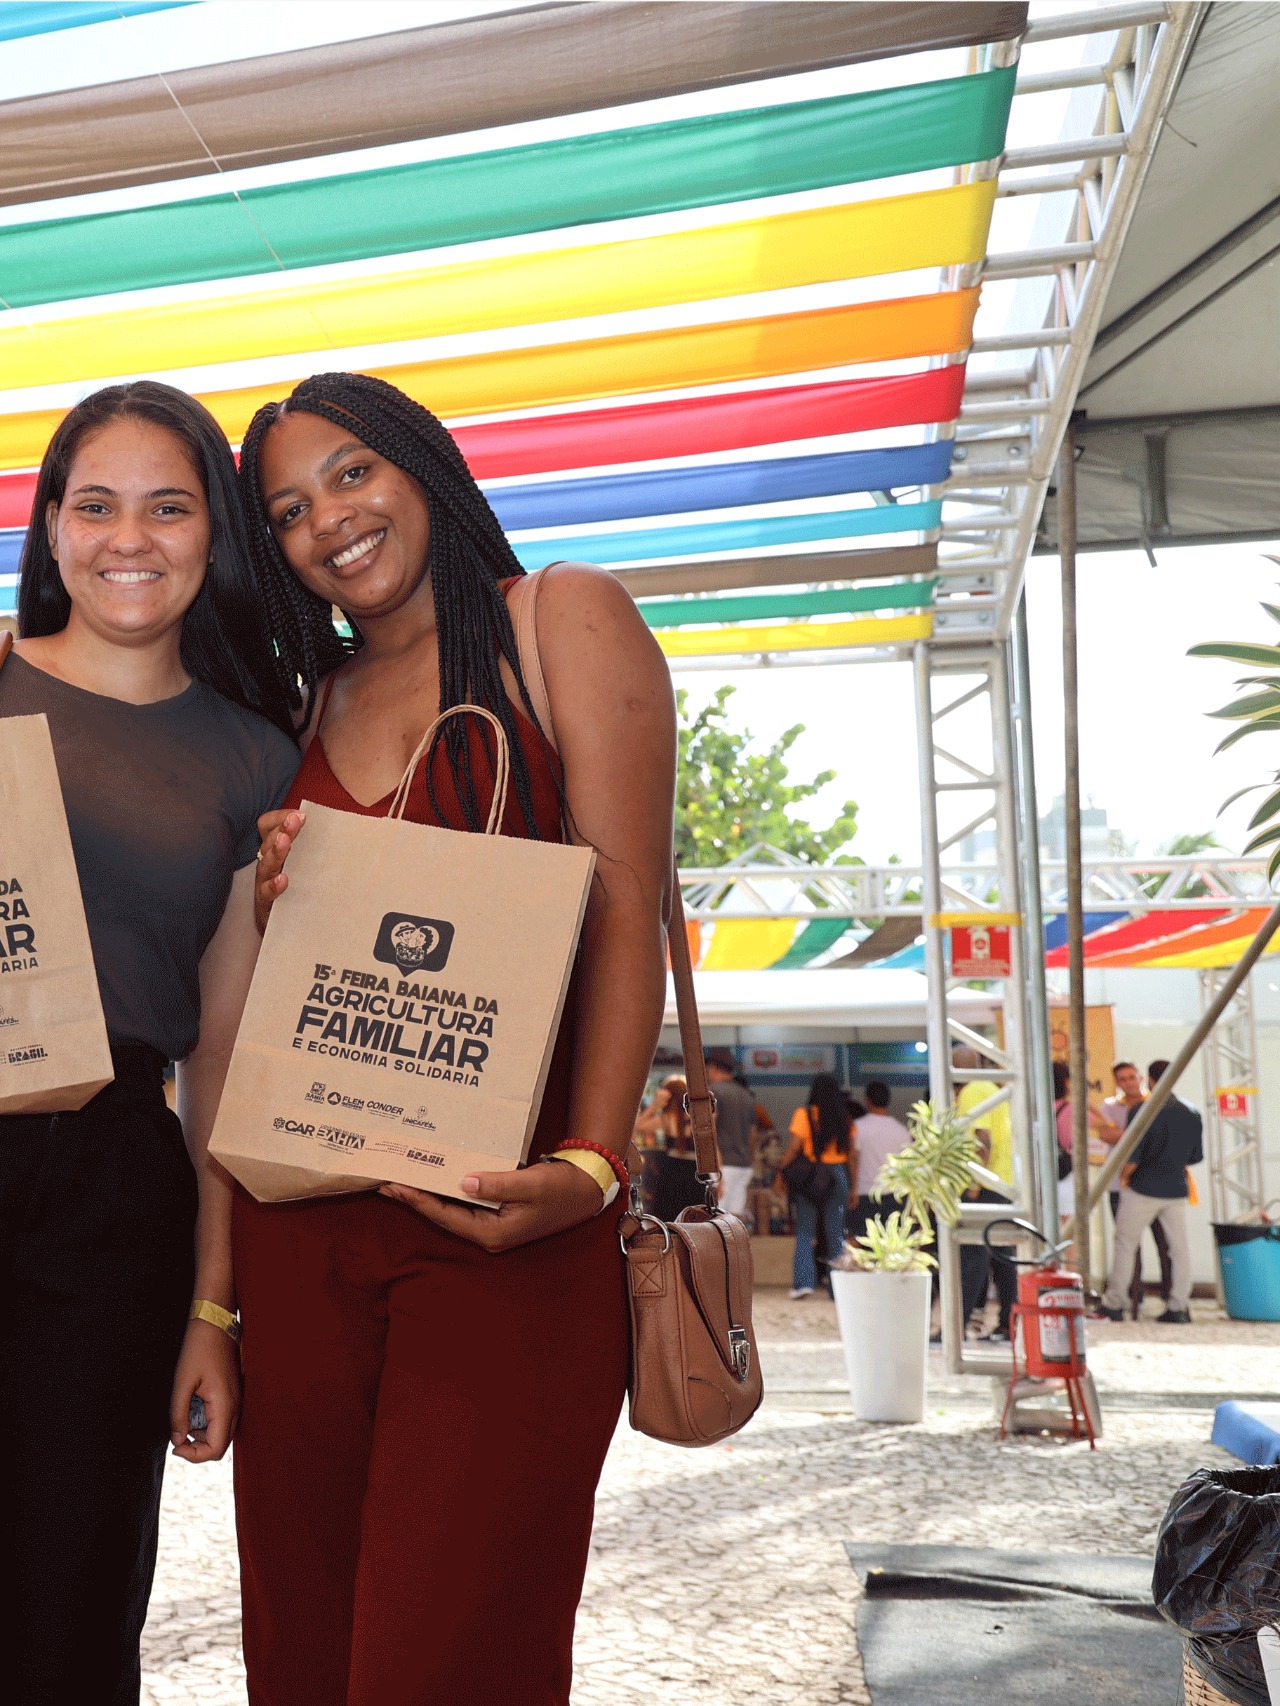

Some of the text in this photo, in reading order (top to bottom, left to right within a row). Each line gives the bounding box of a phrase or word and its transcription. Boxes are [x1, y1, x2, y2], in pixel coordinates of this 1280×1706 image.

[340, 969, 390, 993] FEIRA
[396, 981, 467, 1009] BAIANA
[473, 996, 498, 1015] DA
[306, 983, 494, 1038] AGRICULTURA
[295, 1004, 489, 1073] FAMILIAR
[292, 1037, 479, 1087] E ECONOMIA SOLIDÁRIA
[342, 1095, 365, 1107] FLEM
[366, 1100, 404, 1115] CONDER
[284, 1120, 316, 1136] CAR
[316, 1128, 366, 1150] BAHIA
